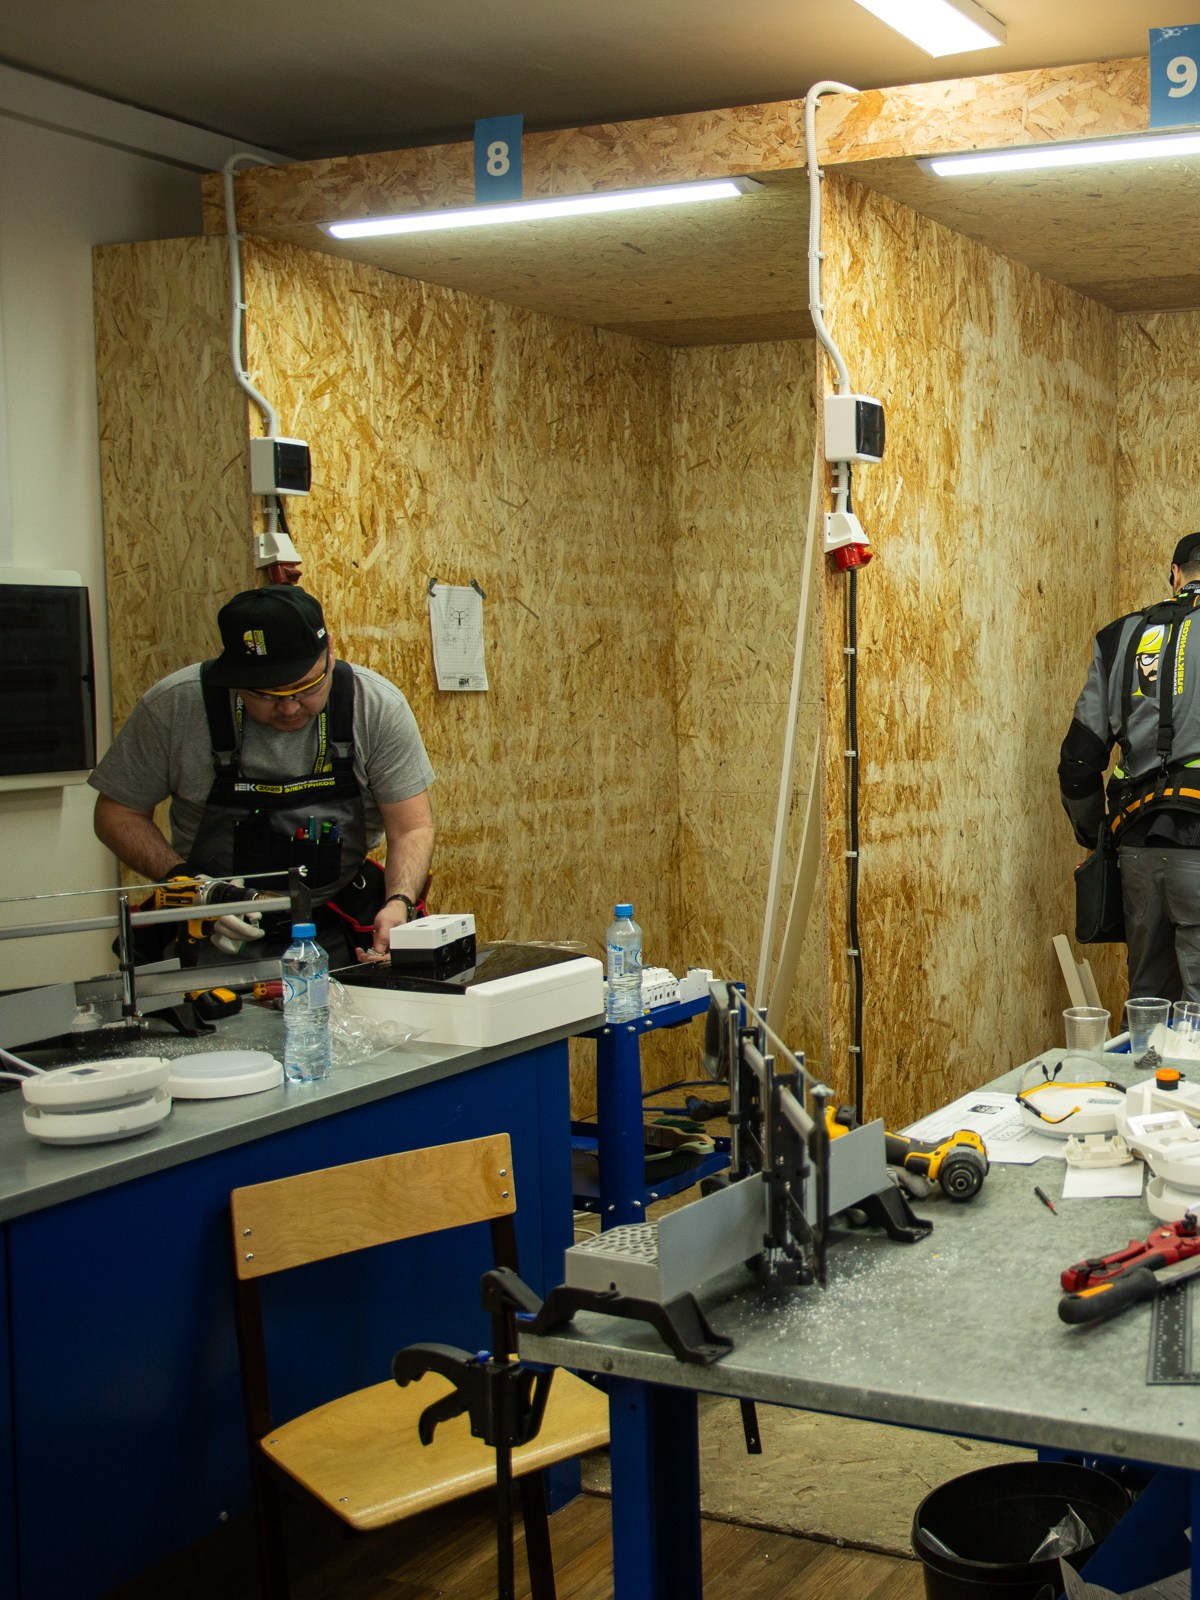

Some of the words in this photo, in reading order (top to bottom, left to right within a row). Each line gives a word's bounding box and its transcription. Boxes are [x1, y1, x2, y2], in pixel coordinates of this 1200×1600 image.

[1167, 56, 1198, 98] 9
[486, 141, 510, 176] 8
[1177, 619, 1192, 695] ЭЛЕКТРИКОВ
[284, 780, 336, 793] ЭЛЕКТРИКОВ
